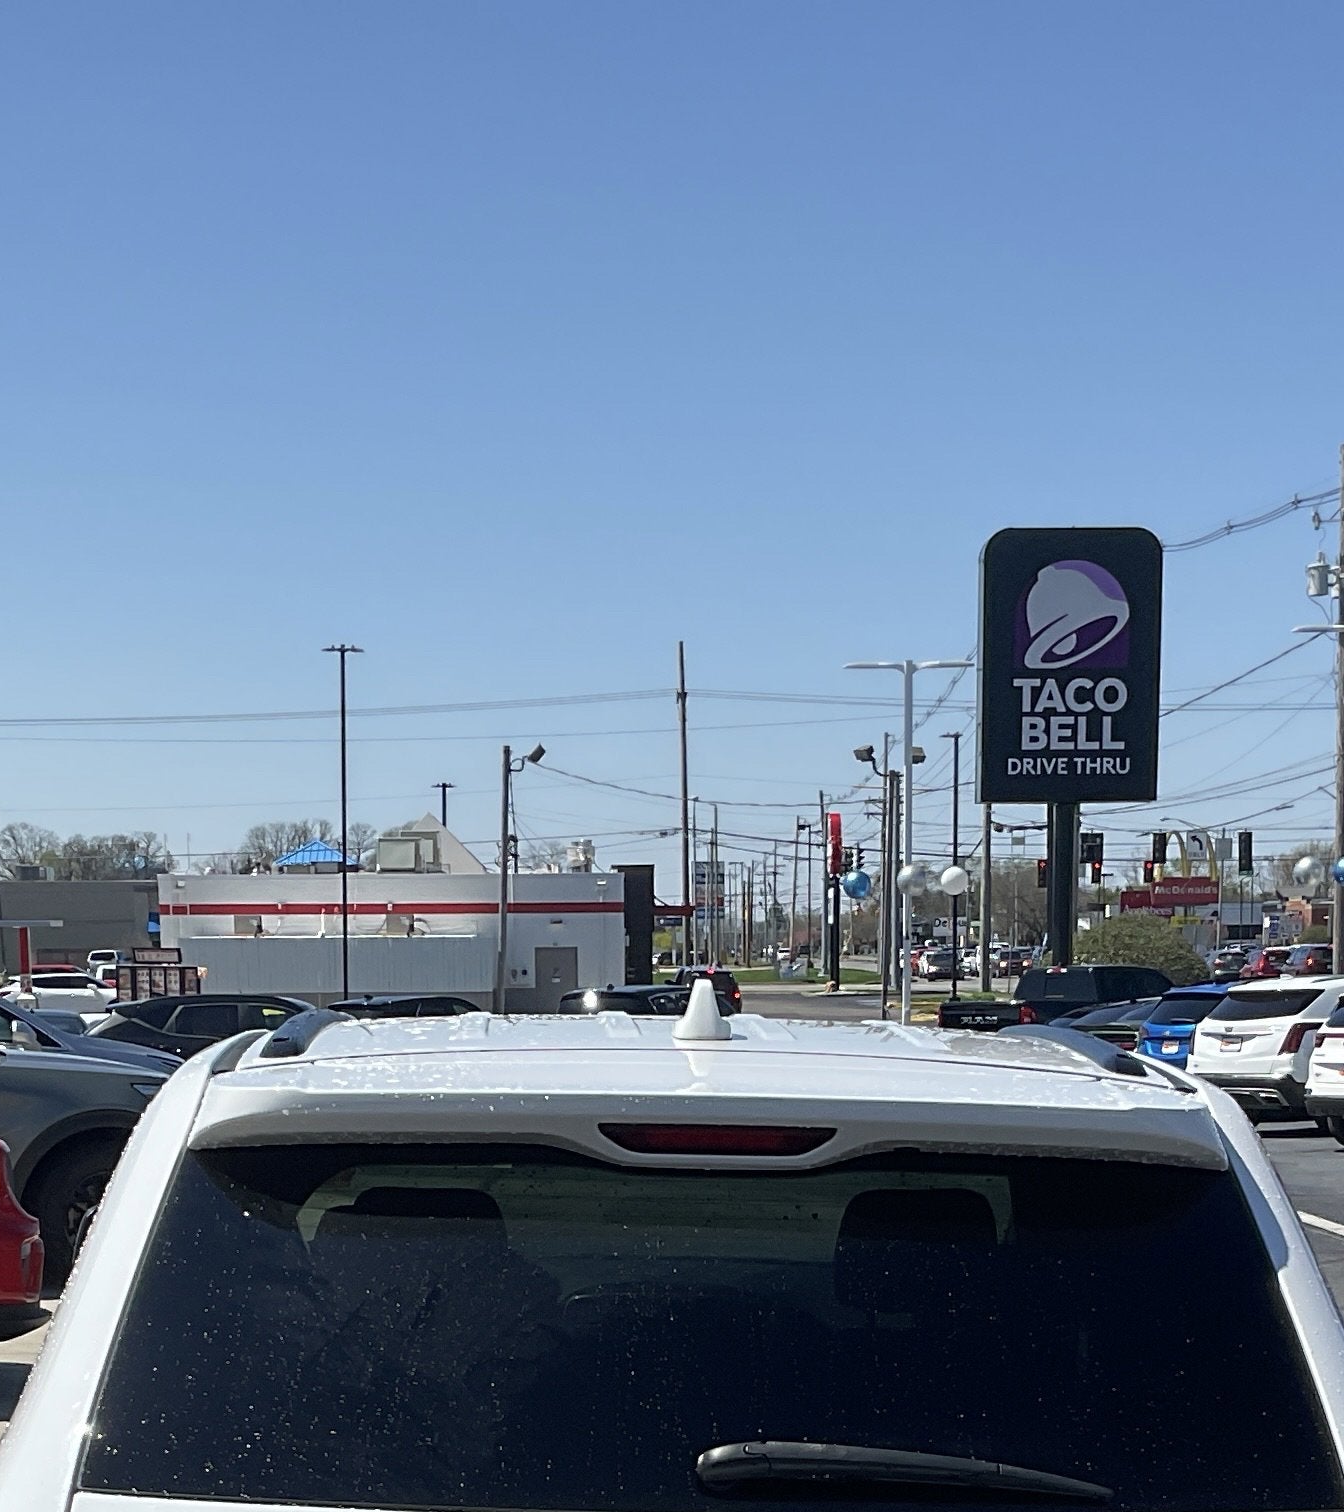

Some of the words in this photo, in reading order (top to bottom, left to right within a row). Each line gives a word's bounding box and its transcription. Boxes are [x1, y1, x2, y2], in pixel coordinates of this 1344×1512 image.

[1012, 677, 1128, 713] TACO
[1020, 716, 1126, 750] BELL
[1007, 757, 1068, 775] DRIVE
[1073, 757, 1131, 775] THRU
